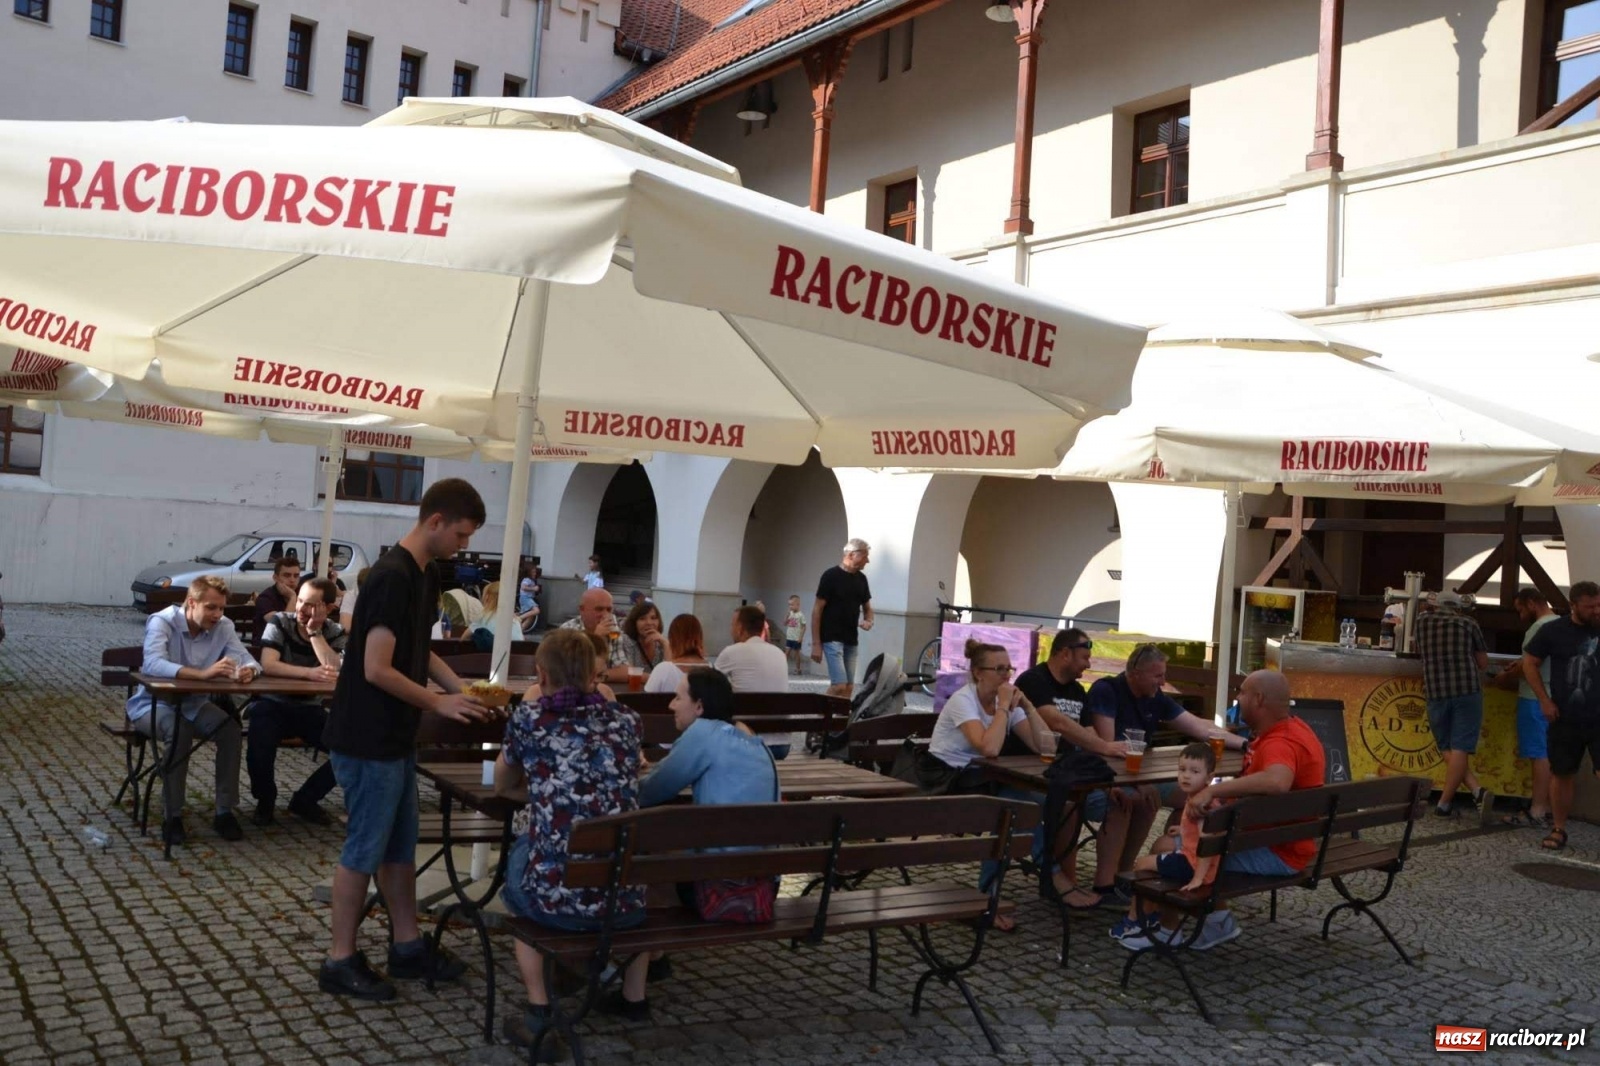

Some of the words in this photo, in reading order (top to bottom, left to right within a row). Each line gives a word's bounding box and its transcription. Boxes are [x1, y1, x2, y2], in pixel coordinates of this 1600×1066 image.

[43, 156, 456, 238] RACIBORSKIE
[769, 244, 1057, 368] RACIBORSKIE
[1280, 440, 1430, 472] RACIBORSKIE
